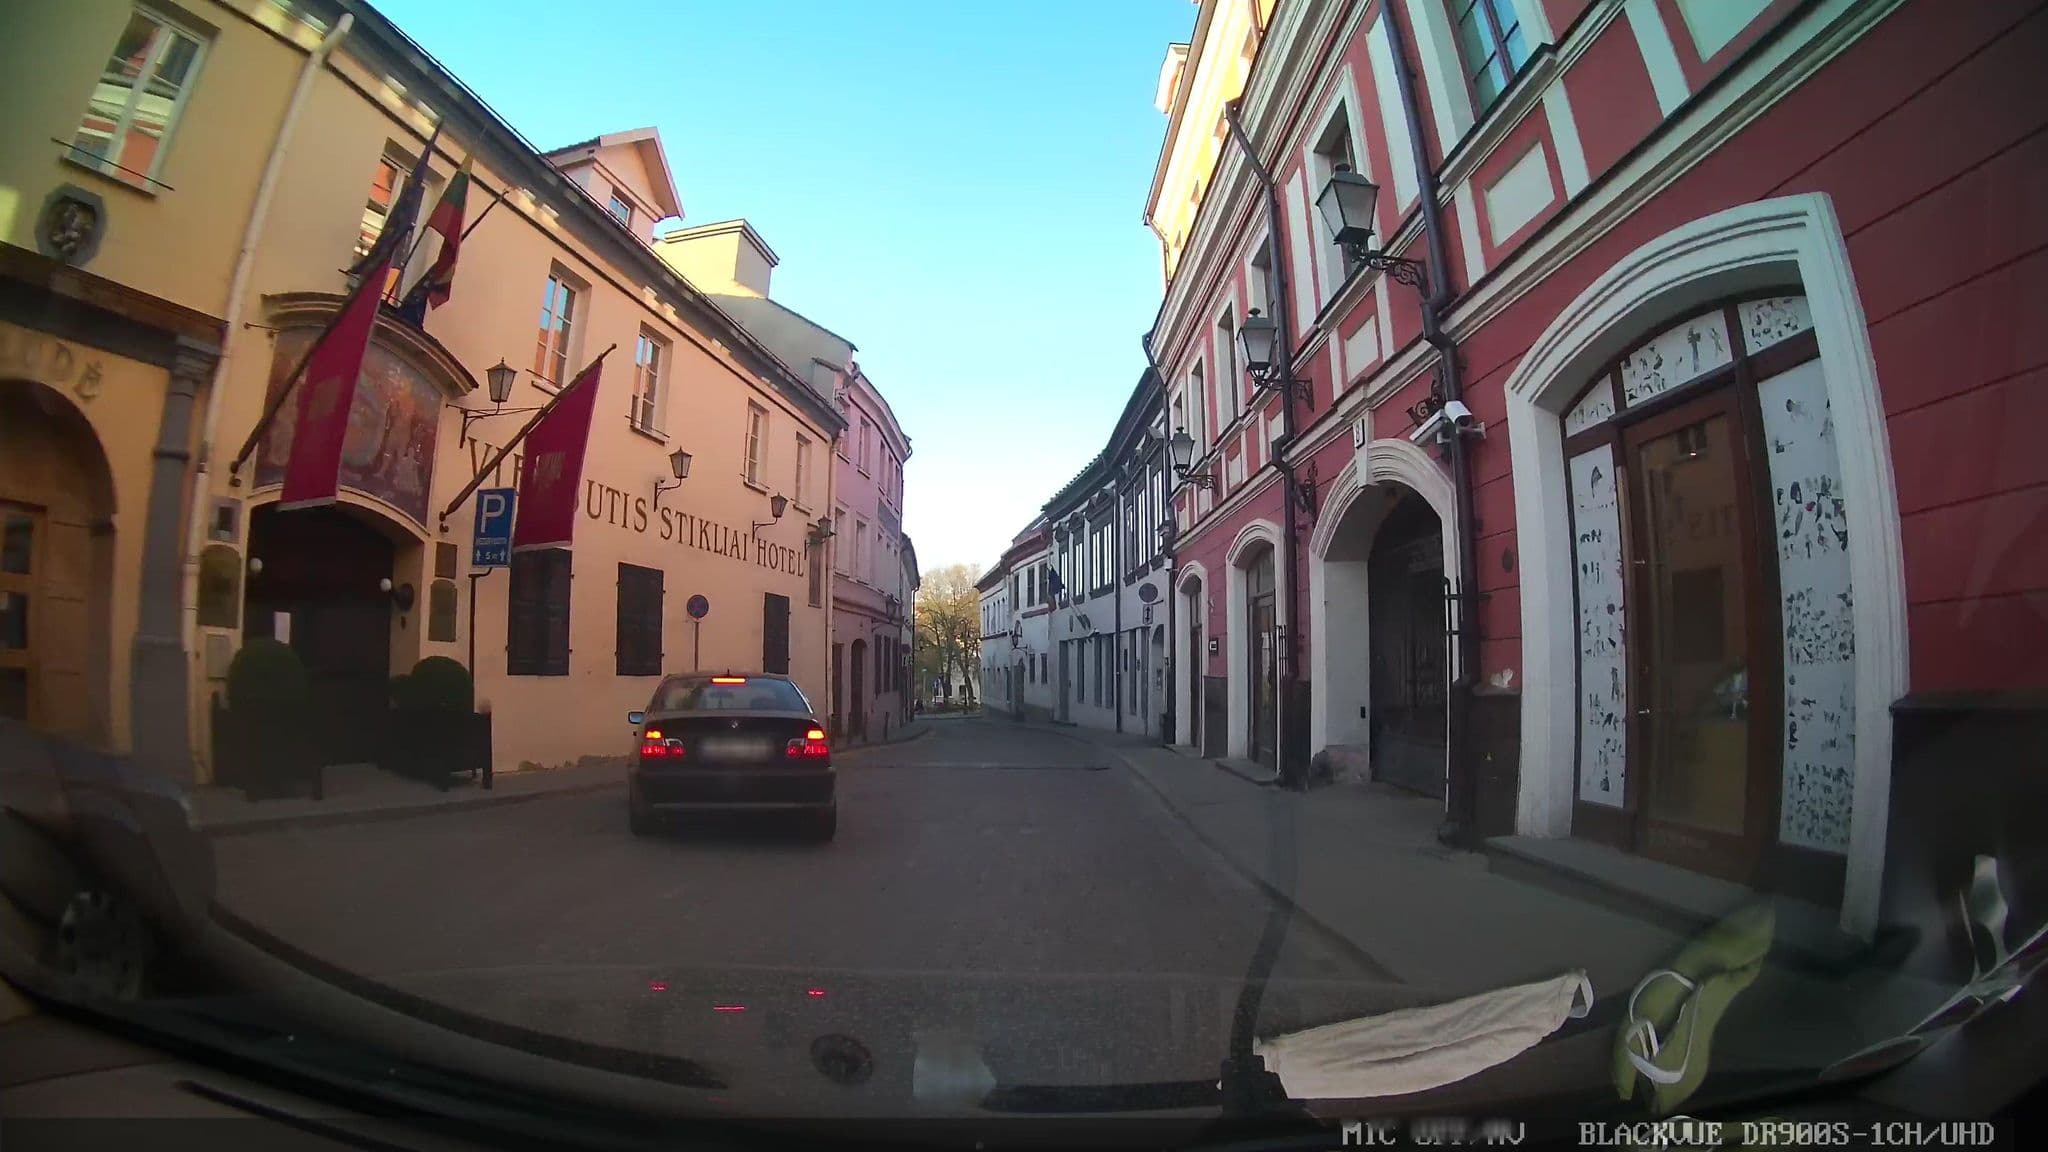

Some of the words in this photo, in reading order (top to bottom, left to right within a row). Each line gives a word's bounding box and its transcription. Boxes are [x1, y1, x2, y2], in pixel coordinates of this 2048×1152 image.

[481, 494, 506, 533] P
[660, 506, 748, 561] STIKLIAI
[757, 538, 804, 577] HOTEL
